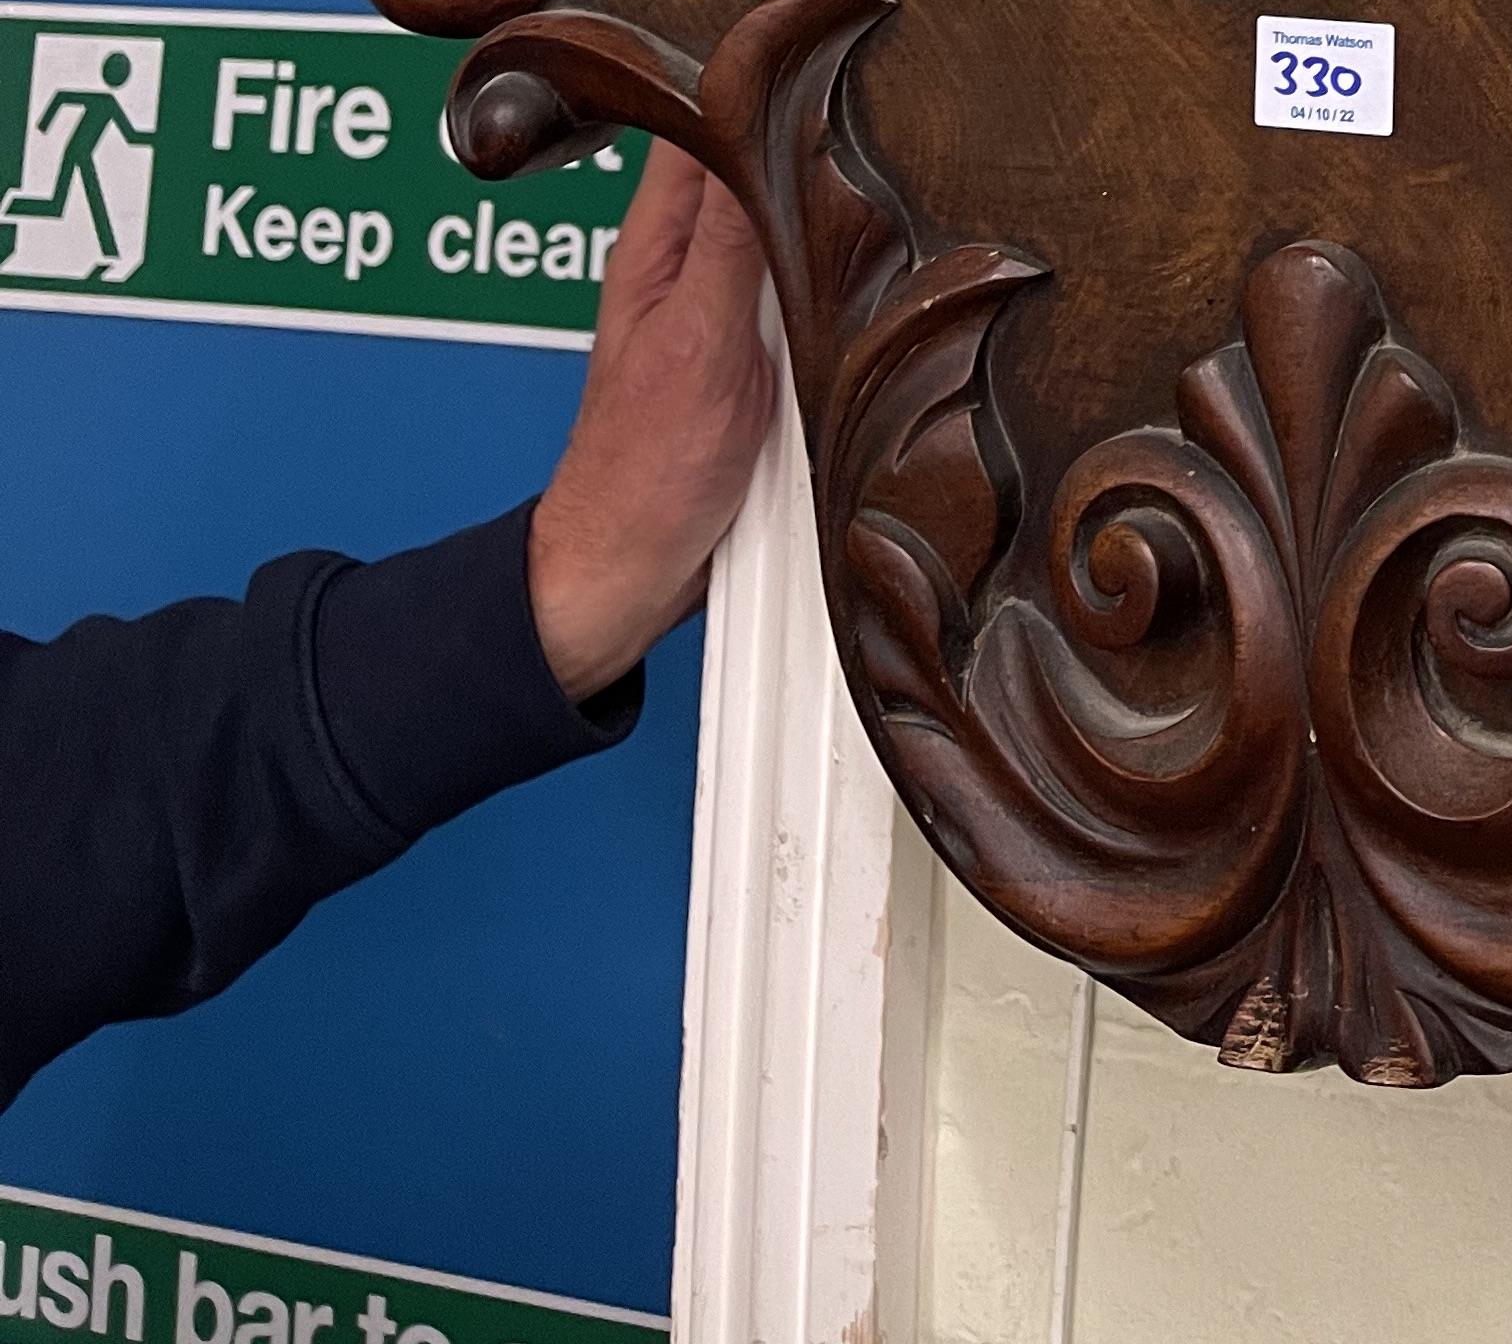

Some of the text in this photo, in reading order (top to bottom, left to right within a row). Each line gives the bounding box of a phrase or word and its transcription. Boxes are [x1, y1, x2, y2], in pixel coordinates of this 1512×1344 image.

[1271, 51, 1362, 98] 330
[1272, 31, 1373, 50] Thomas Watson
[211, 57, 392, 160] Fire
[202, 184, 620, 281] Keep clear
[176, 1250, 334, 1344] bar
[357, 1293, 451, 1344] t
